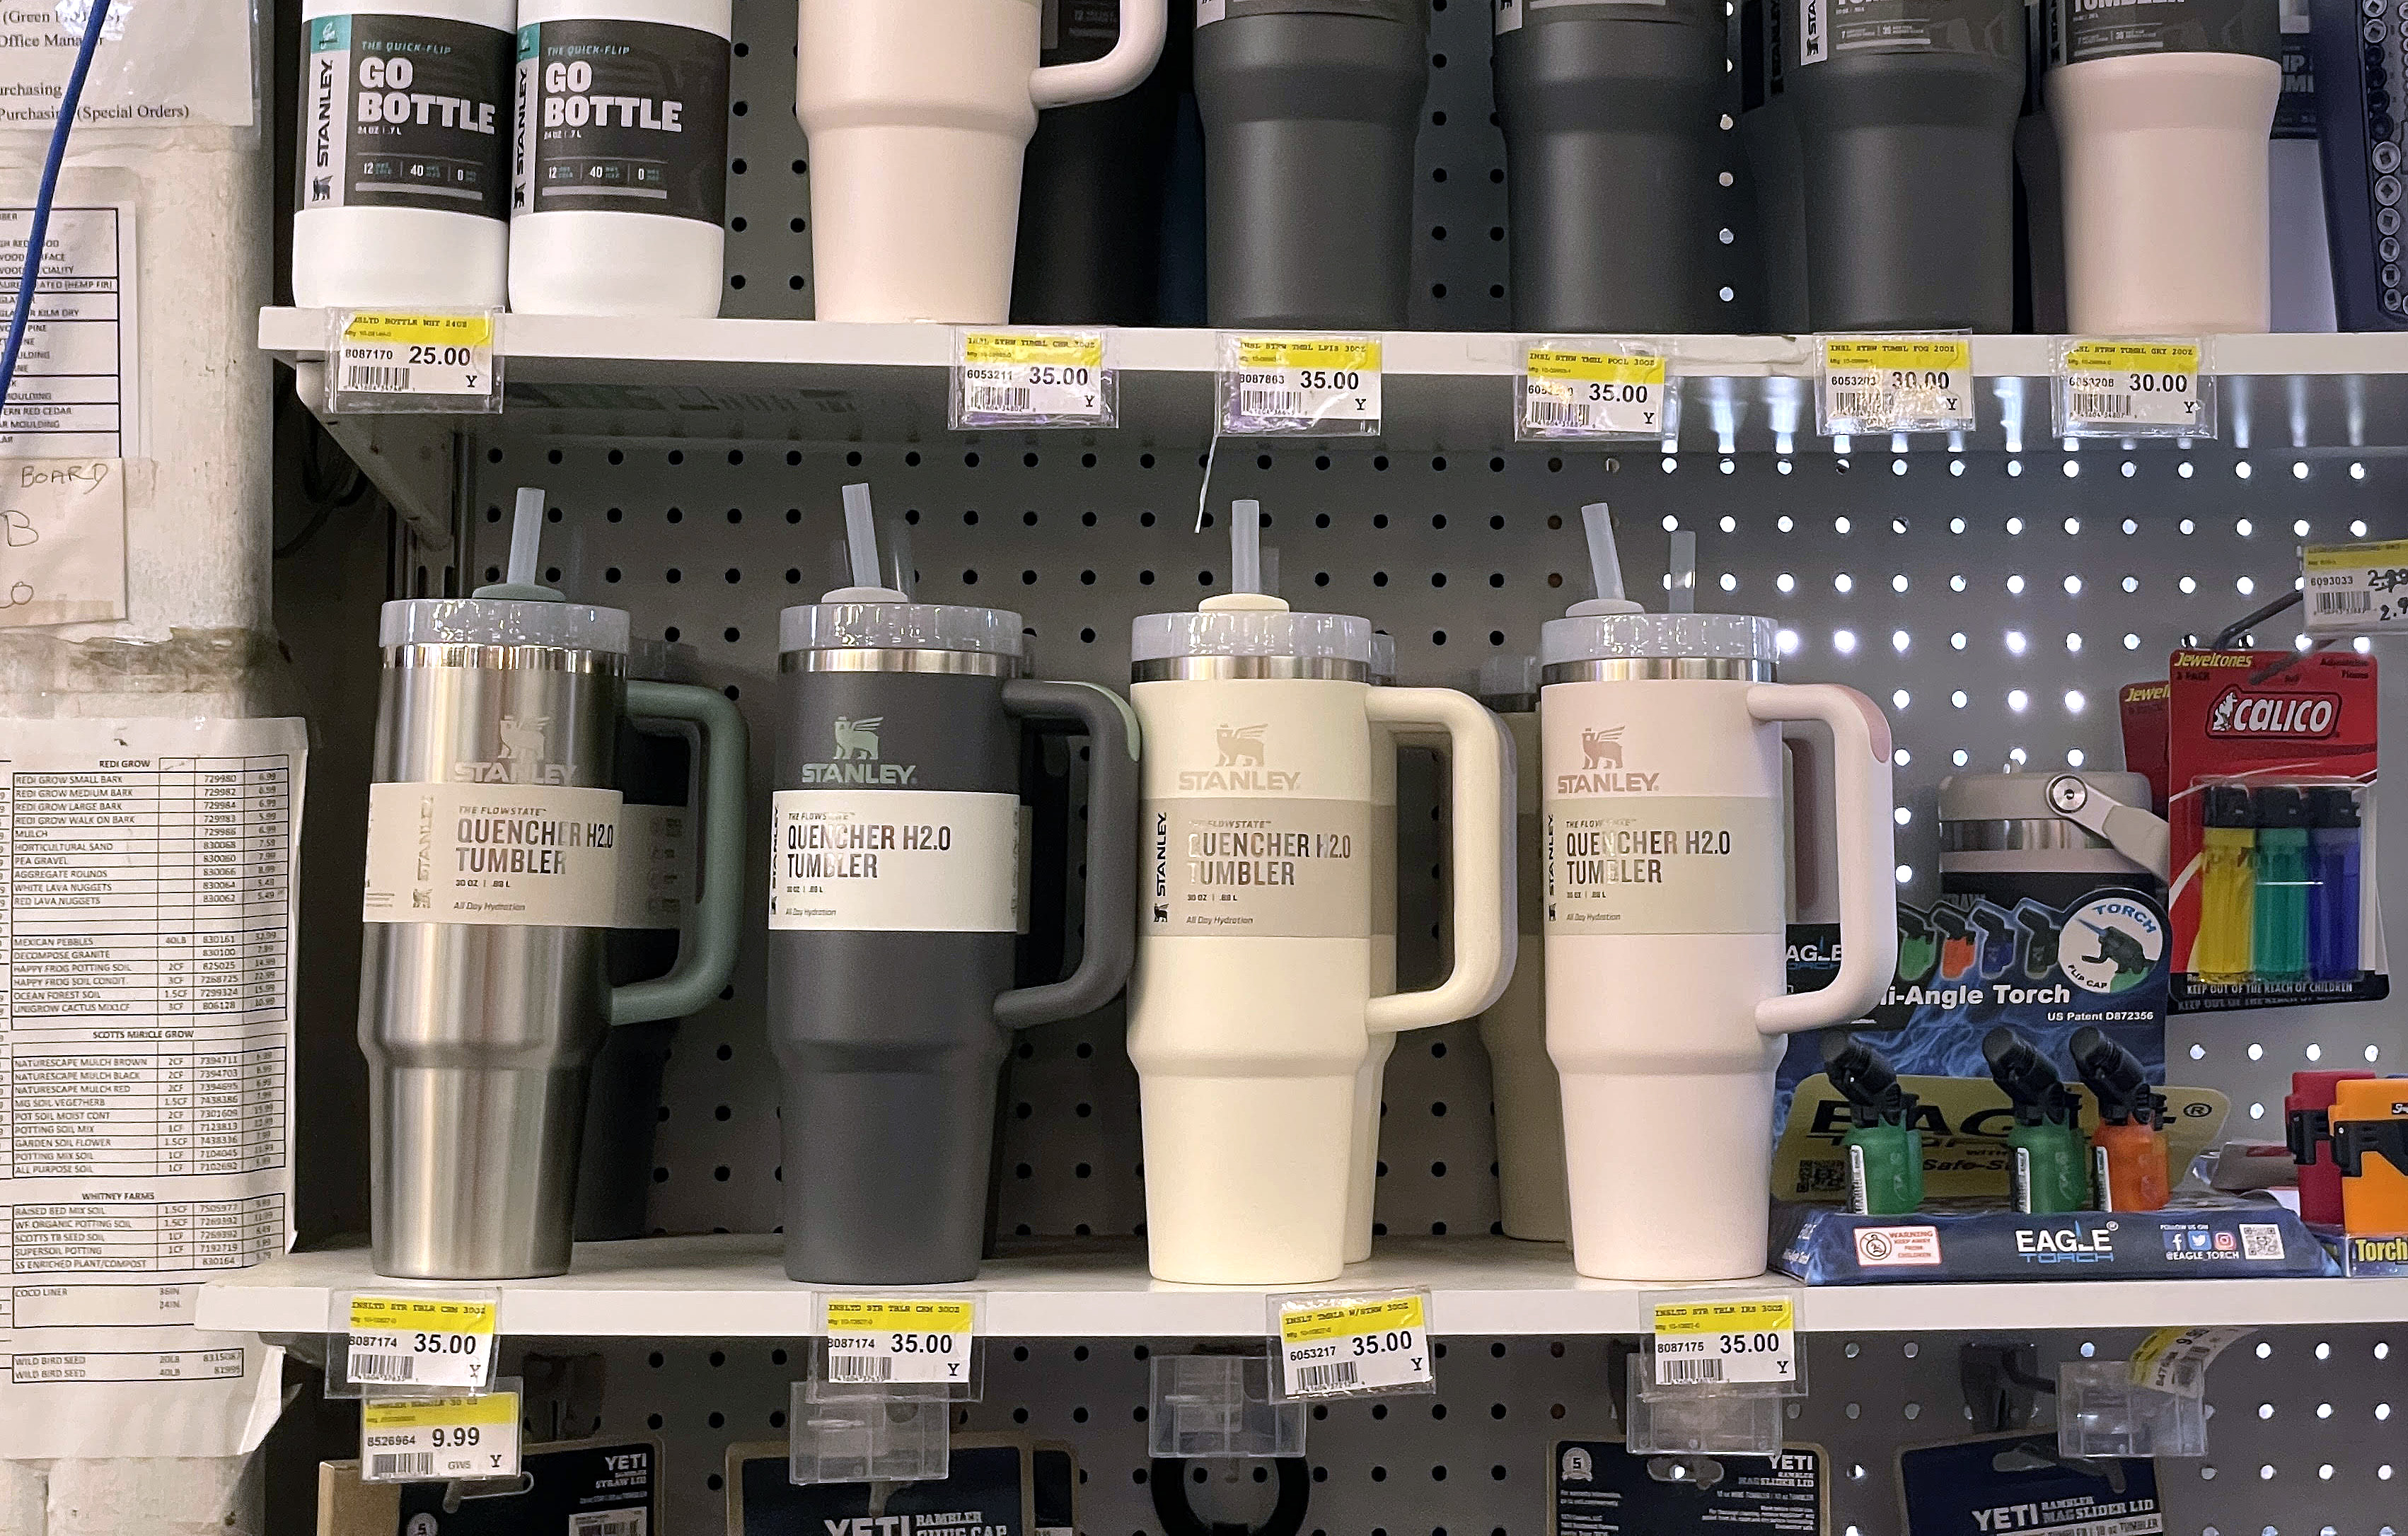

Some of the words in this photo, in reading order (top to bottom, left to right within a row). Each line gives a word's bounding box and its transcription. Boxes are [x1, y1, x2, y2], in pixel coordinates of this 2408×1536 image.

[3, 10, 50, 25] (Green
[362, 41, 381, 51] THE
[386, 42, 452, 54] QUICK-FLIP
[548, 47, 563, 56] THE
[568, 45, 630, 56] QUICK-FLIP
[359, 57, 413, 89] GO
[545, 60, 593, 93] GO
[77, 104, 132, 122] (Special
[137, 104, 190, 119] Orders)
[317, 59, 333, 168] STANLEY
[358, 91, 495, 134] BOTTLE
[516, 69, 528, 175] STANLEY
[544, 95, 683, 133] BOTTLE
[364, 162, 374, 174] 12
[410, 164, 424, 177] 40
[548, 167, 557, 179] 12
[589, 166, 603, 178] 40
[345, 349, 393, 359] 8087170
[409, 346, 471, 366] 25.00
[465, 375, 477, 388] Y
[967, 369, 1012, 380] 6053211
[1029, 366, 1088, 385] 35.00
[1300, 371, 1359, 390] 35.00
[1892, 371, 1950, 390] 3000
[2129, 373, 2187, 392] 30.00
[1084, 395, 1095, 407] Y
[1589, 383, 1648, 403] 35.00
[1355, 398, 1367, 411] Y
[1947, 398, 1957, 410] Y
[2184, 401, 2194, 414] Y
[1643, 412, 1655, 424] Y
[21, 464, 108, 494] BOARD
[2310, 576, 2353, 586] 6093033
[2174, 651, 2254, 668] Jeweltones
[122, 760, 151, 768] GROW
[454, 762, 577, 784] STANLEY
[802, 763, 917, 784] STANLEY
[1179, 770, 1301, 791] STANLEY
[1558, 772, 1660, 793] STANLEY
[458, 818, 581, 847] QUENCHER
[587, 823, 613, 849] H2.0
[788, 825, 895, 850] QUENCHER
[903, 825, 951, 851] H2.0
[1157, 811, 1167, 897] STANLEY
[1188, 832, 1309, 859] QUENCHER
[1316, 834, 1351, 859] H2.0
[1566, 830, 1679, 858] QUENCHER
[1686, 830, 1731, 855] H2.0
[456, 846, 566, 875] TUMBLER
[787, 853, 878, 878] TUMBLER
[1187, 861, 1295, 885] TUMBLER
[1566, 859, 1662, 885] TUMBLER
[2092, 904, 2157, 933] TORCH
[2068, 964, 2085, 982] FLIP
[1993, 984, 2070, 1004] Torch
[2086, 979, 2108, 989] CAP
[2047, 1012, 2063, 1021] US
[2067, 1012, 2102, 1020] Patent
[2105, 1011, 2154, 1020] D872356
[2015, 1228, 2112, 1252] EAGLE
[2356, 1238, 2408, 1262] Torch
[2019, 1252, 2114, 1264] TORCH
[413, 1332, 477, 1355] 35.00
[828, 1338, 876, 1349] 8087174
[891, 1333, 953, 1354] 35.00
[1290, 1346, 1336, 1361] 6053217
[1352, 1330, 1413, 1356] 35.00
[1657, 1342, 1705, 1354] 8087175
[1720, 1332, 1780, 1354] 35.00
[947, 1363, 961, 1376] Y
[1411, 1357, 1423, 1371] Y
[1776, 1360, 1789, 1374] Y
[367, 1436, 416, 1448] 8526964
[432, 1426, 481, 1448] 9.99
[490, 1454, 502, 1468] Y
[605, 1453, 647, 1471] YETI
[1768, 1454, 1814, 1470] YETI
[823, 1514, 910, 1536] YETI
[1972, 1503, 2039, 1532] YETI
[2129, 1499, 2154, 1513] LID
